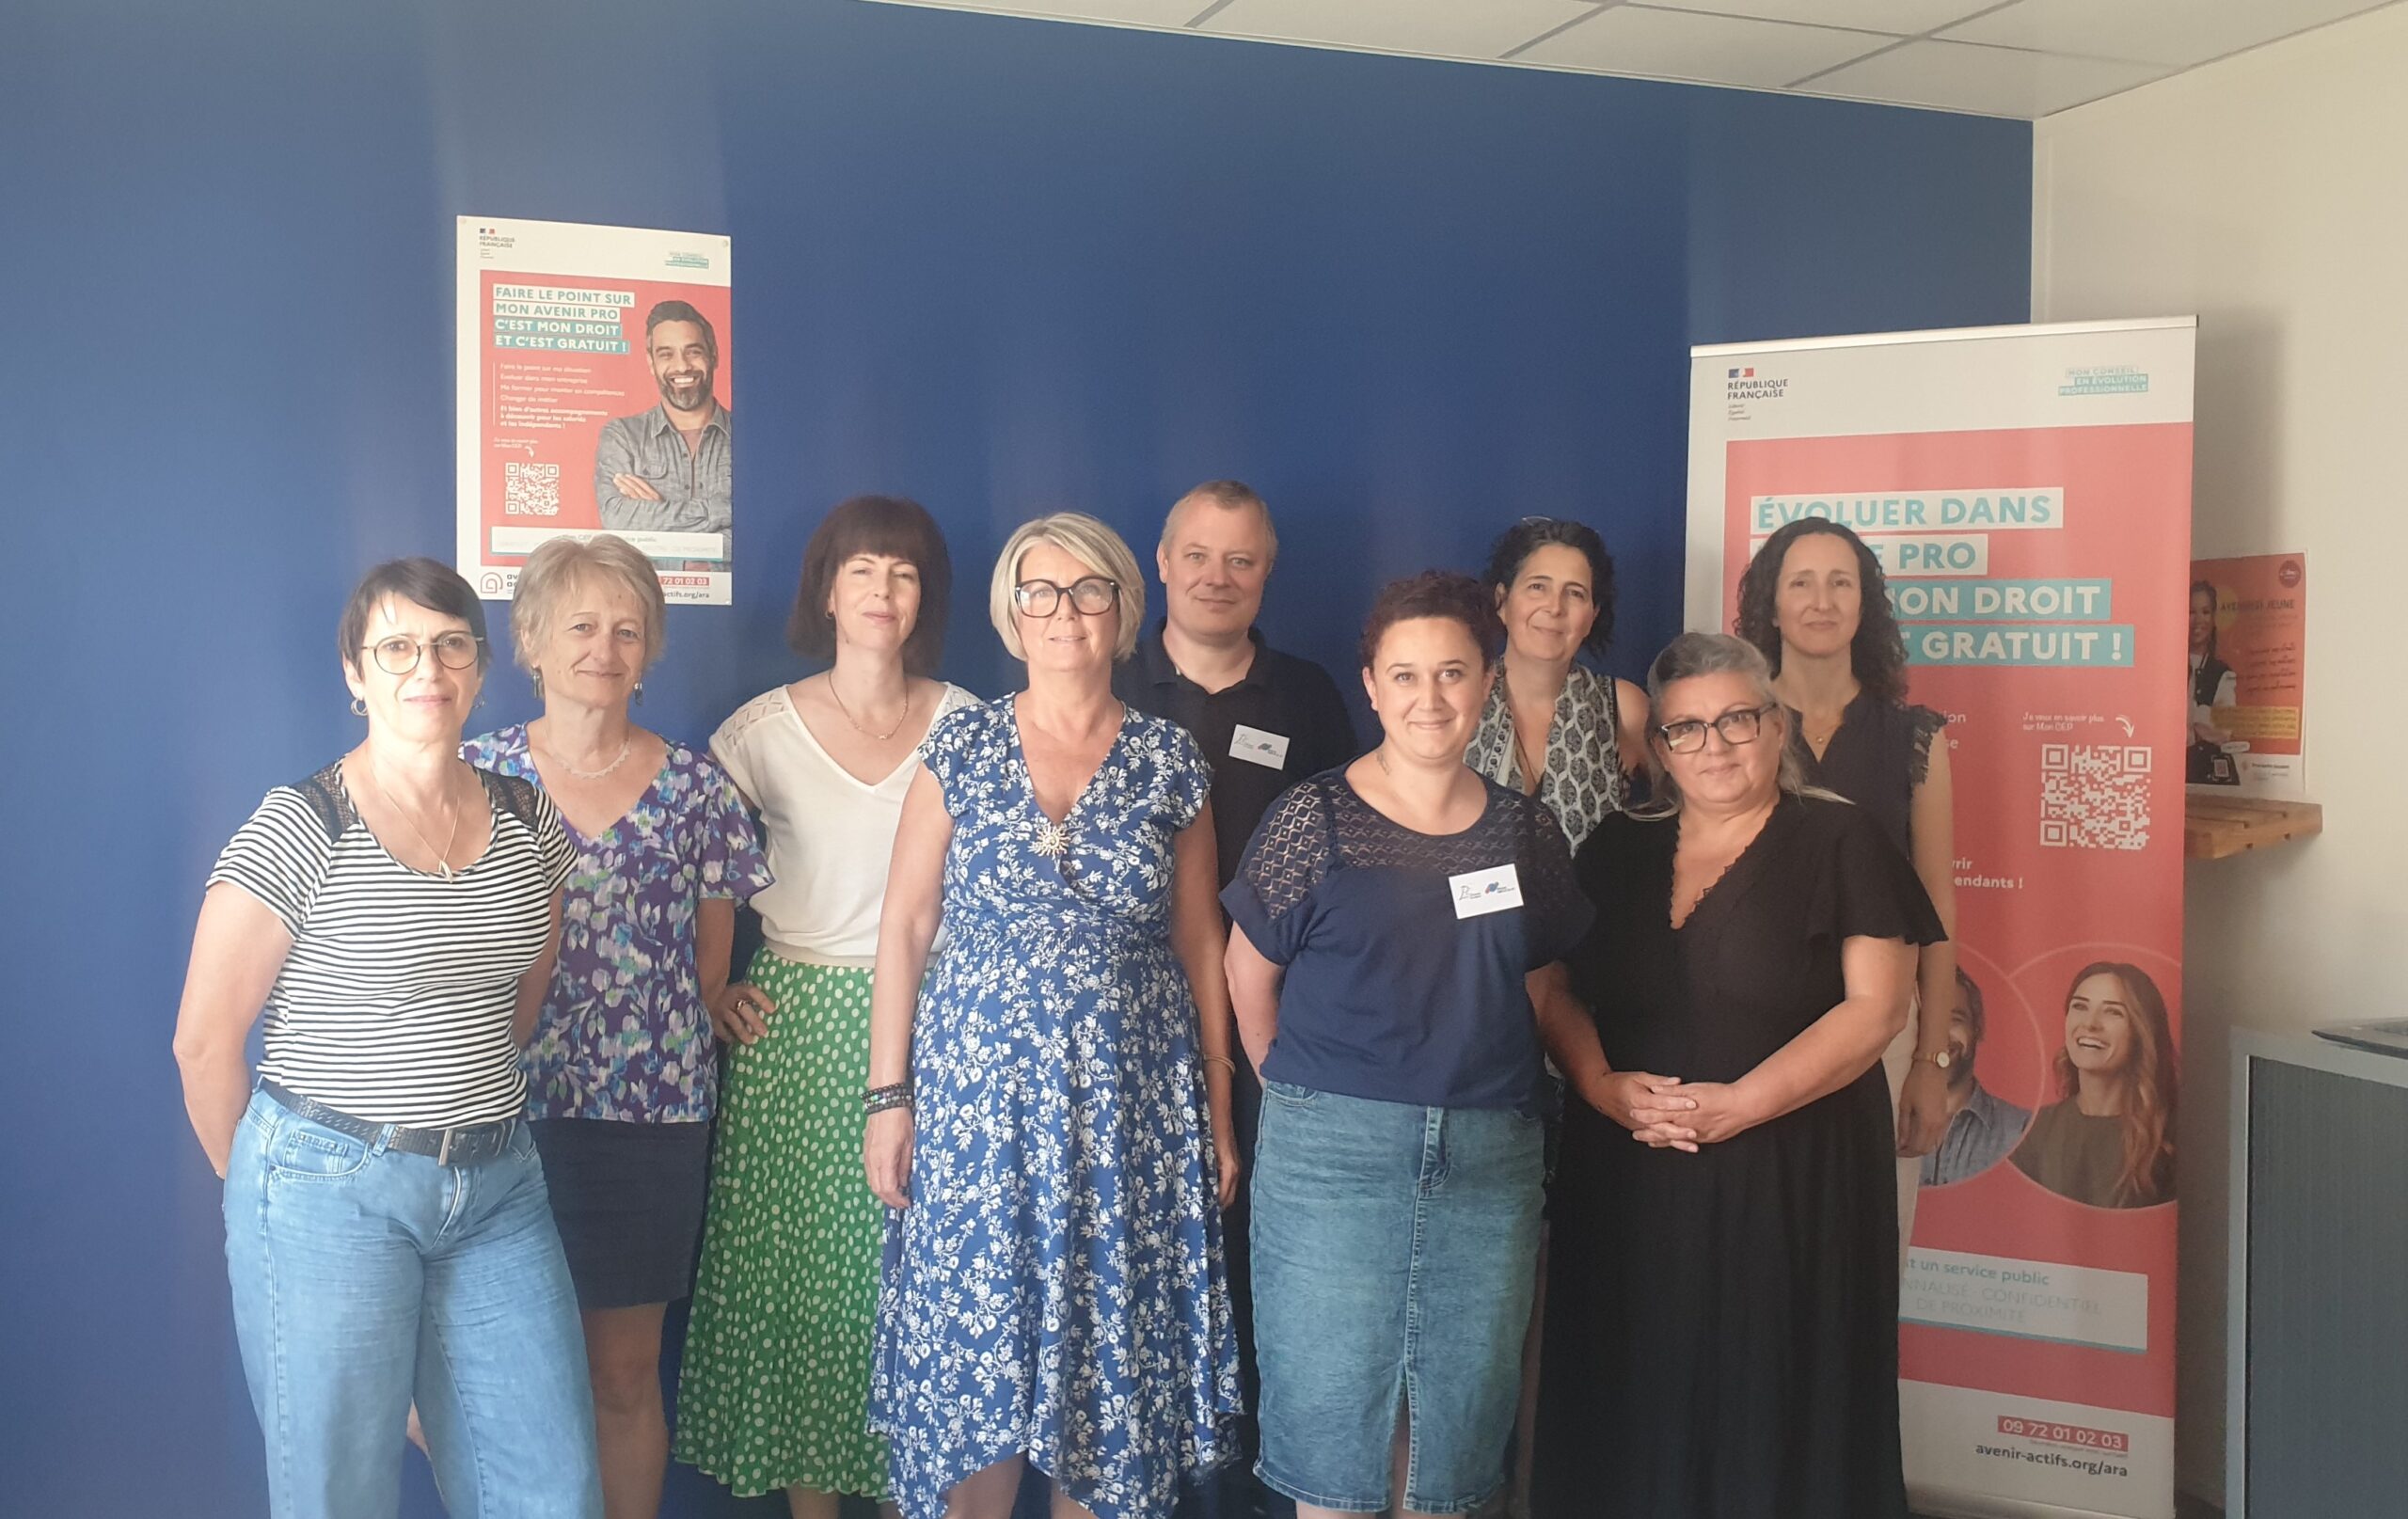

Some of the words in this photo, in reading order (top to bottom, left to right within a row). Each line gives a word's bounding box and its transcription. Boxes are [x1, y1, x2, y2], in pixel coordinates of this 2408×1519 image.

[496, 287, 534, 299] FAIRE
[539, 290, 553, 300] LE
[558, 291, 602, 303] POINT
[605, 293, 631, 305] SUR
[496, 303, 529, 314] MON
[534, 305, 586, 318] AVENIR
[591, 309, 618, 320] PRO
[495, 319, 533, 330] C'EST
[537, 322, 571, 334] MON
[576, 324, 619, 336] DROIT
[495, 335, 512, 346] ET
[515, 336, 554, 348] C'EST
[557, 339, 618, 352] GRATUIT
[622, 341, 626, 352] !
[1727, 378, 1789, 390] RÉPUBLIQUE
[1727, 389, 1784, 400] FRANÇAISE
[1759, 497, 1926, 529] ÉVOLUER
[1941, 495, 2052, 525] DANS
[1899, 542, 1977, 570] PRO
[1975, 585, 2101, 615] DROIT
[1921, 631, 2099, 660] GRATUIT
[2112, 632, 2122, 660] !
[2023, 712, 2034, 720] Je
[2088, 713, 2104, 723] plus
[1955, 875, 2014, 888] endants
[1921, 1260, 1940, 1272] un
[1943, 1262, 1997, 1279] service
[2002, 1270, 2051, 1286] public
[1917, 1298, 1934, 1311] DE
[1981, 1287, 2102, 1315] CONFIDENTIEL
[2003, 1418, 2023, 1433] 09
[2029, 1422, 2048, 1438] 72
[2052, 1426, 2069, 1441] 01
[2076, 1430, 2096, 1445] 02
[2101, 1433, 2122, 1449] 03
[1975, 1445, 2128, 1477] avenir-actifs.org/ara
